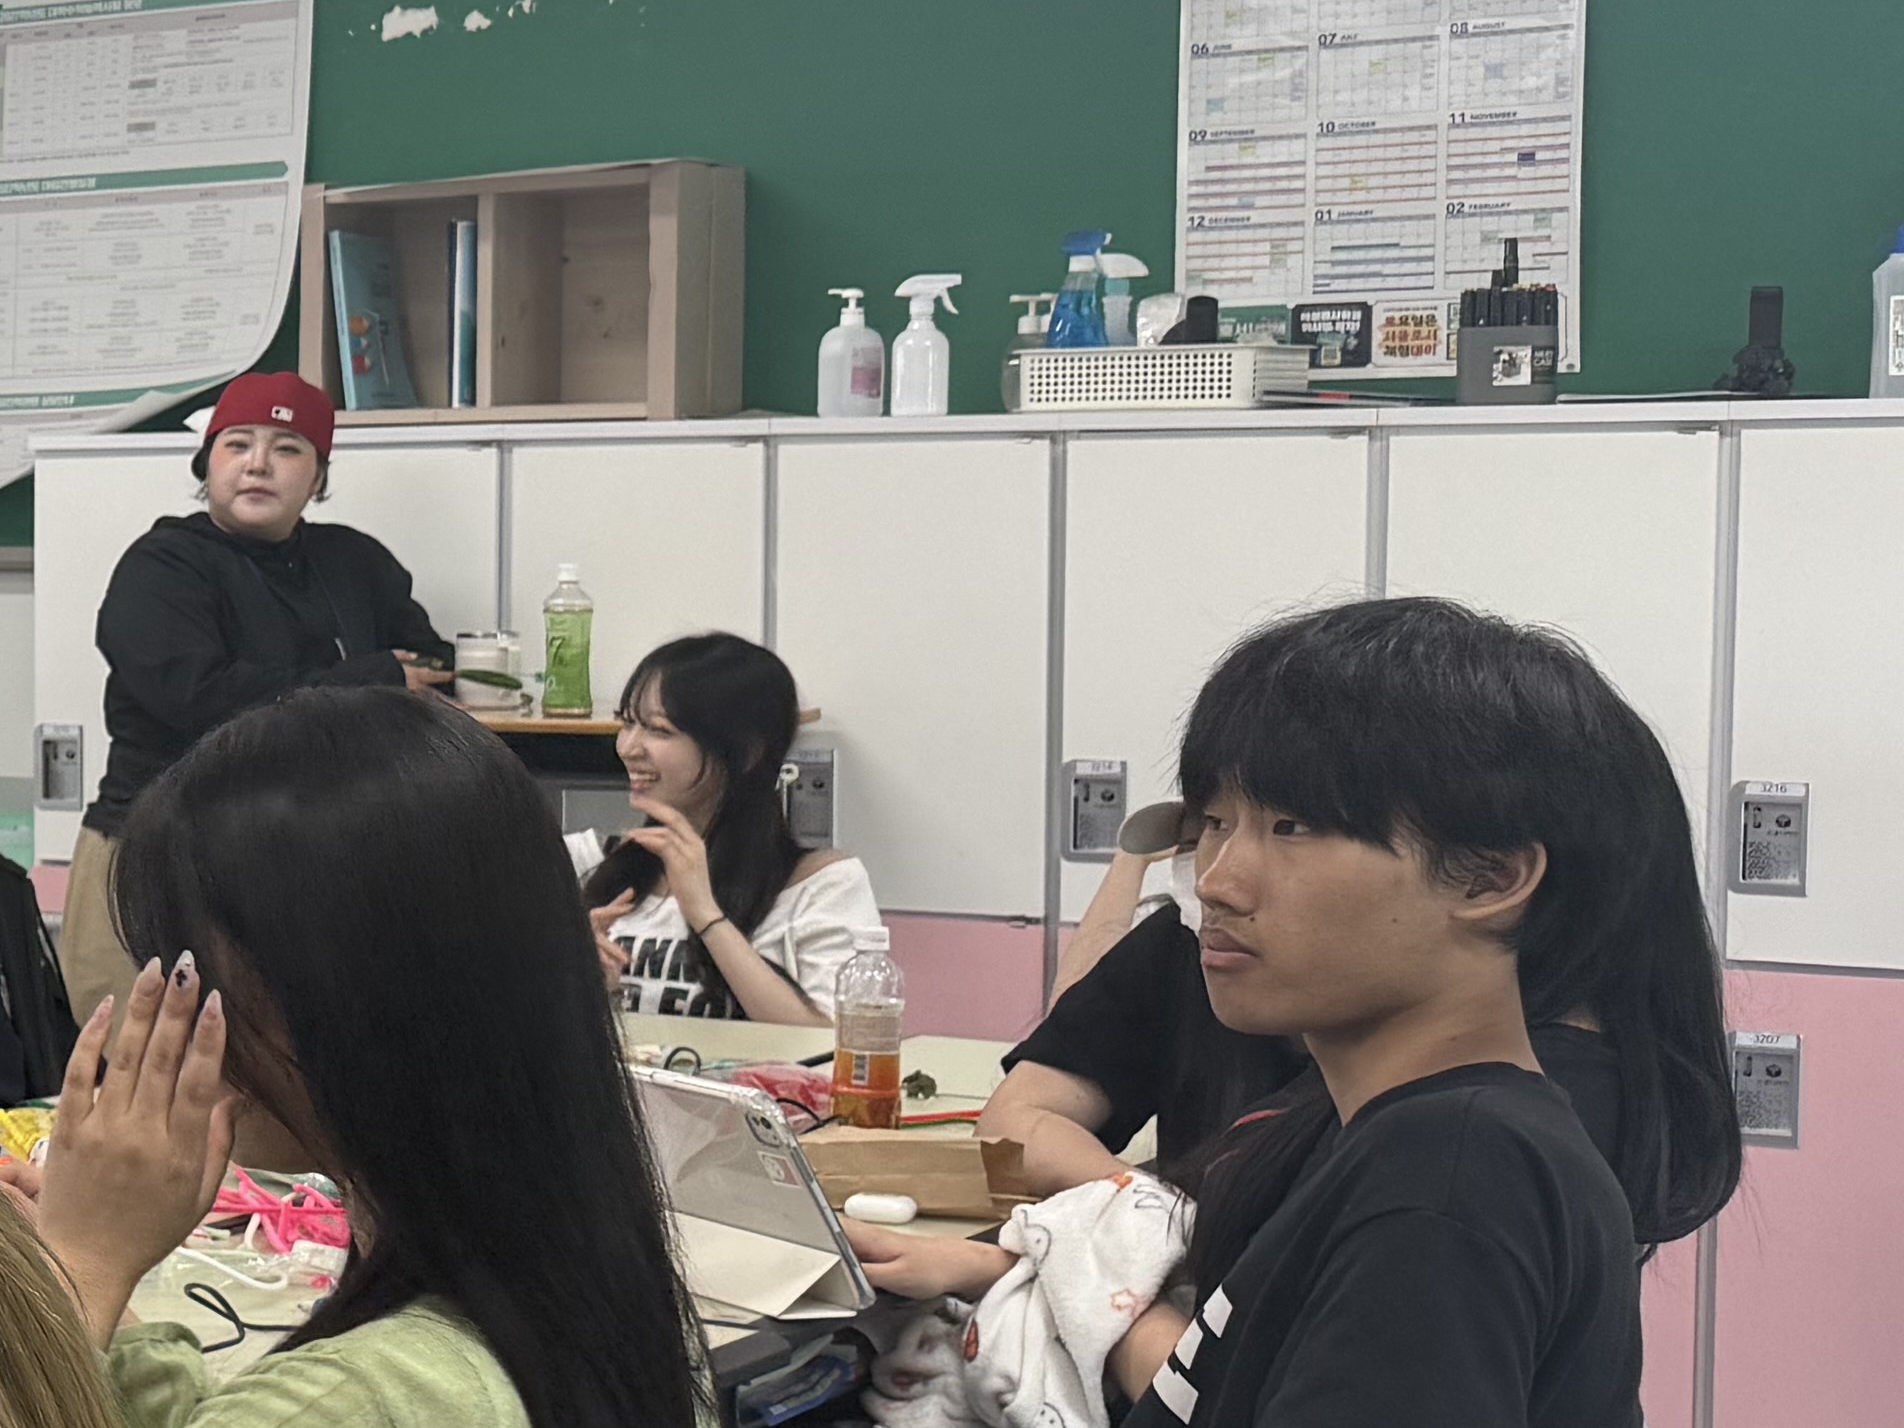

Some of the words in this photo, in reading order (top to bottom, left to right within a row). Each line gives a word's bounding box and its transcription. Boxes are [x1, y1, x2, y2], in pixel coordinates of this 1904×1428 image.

[1450, 22, 1468, 34] 08
[1318, 33, 1336, 46] 07
[1191, 43, 1209, 55] 06
[1449, 112, 1465, 124] 11
[1317, 122, 1335, 133] 10
[1189, 130, 1207, 141] 09
[1446, 203, 1465, 214] 02
[1314, 209, 1333, 221] 01
[1188, 216, 1206, 228] 12
